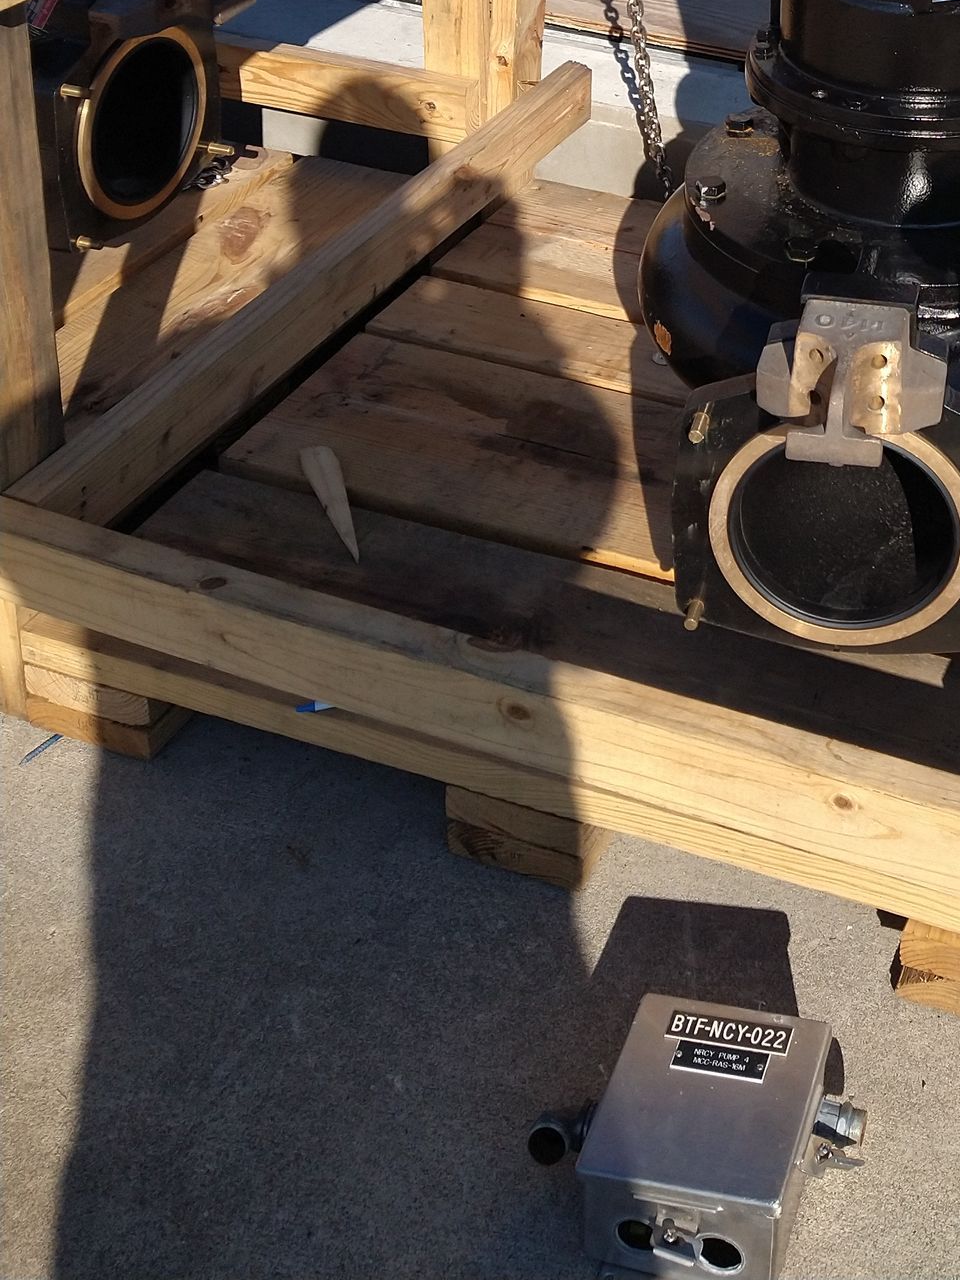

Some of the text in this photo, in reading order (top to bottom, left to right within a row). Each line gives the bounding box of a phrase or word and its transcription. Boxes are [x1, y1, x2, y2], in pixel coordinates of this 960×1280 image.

[671, 1014, 787, 1049] BTF-NCY-022
[693, 1048, 715, 1058] NRCY
[718, 1052, 740, 1061] PUMP
